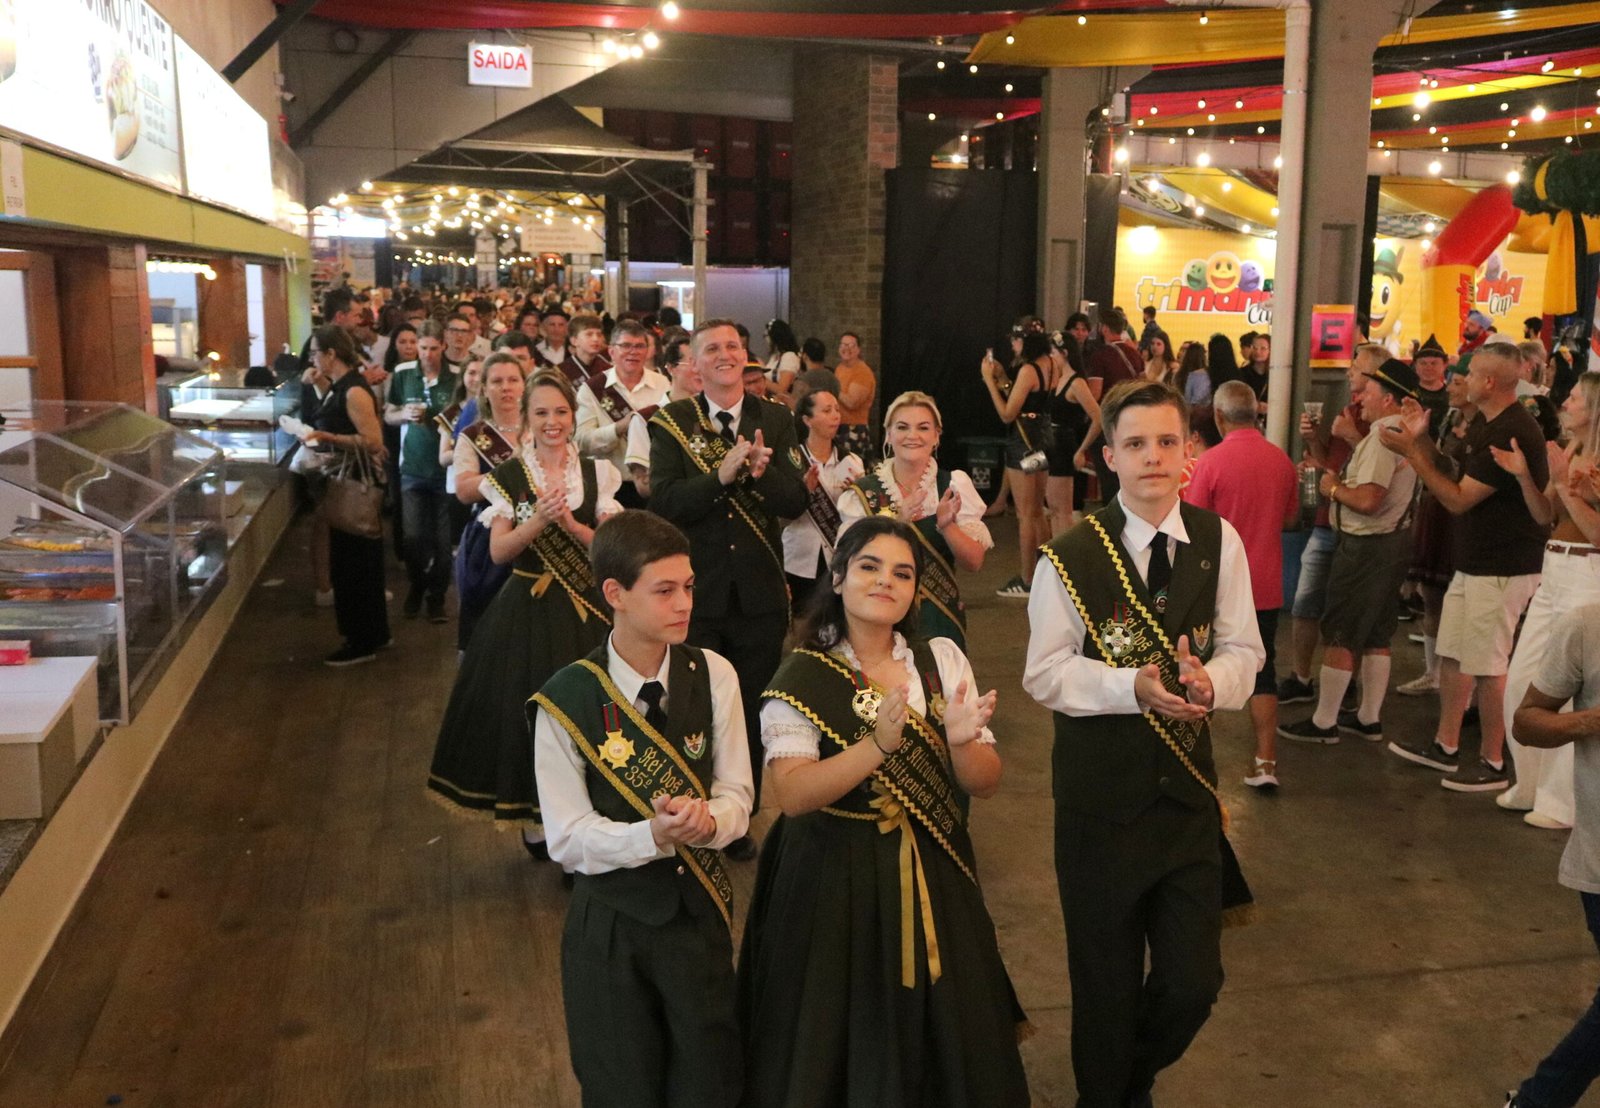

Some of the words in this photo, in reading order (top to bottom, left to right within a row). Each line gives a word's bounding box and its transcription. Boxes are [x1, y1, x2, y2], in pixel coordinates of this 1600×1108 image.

[473, 49, 528, 71] SAIDA
[1489, 295, 1513, 316] Cap
[1321, 319, 1345, 352] E
[1133, 627, 1153, 652] dos
[639, 747, 667, 776] Rei
[660, 765, 683, 794] dos
